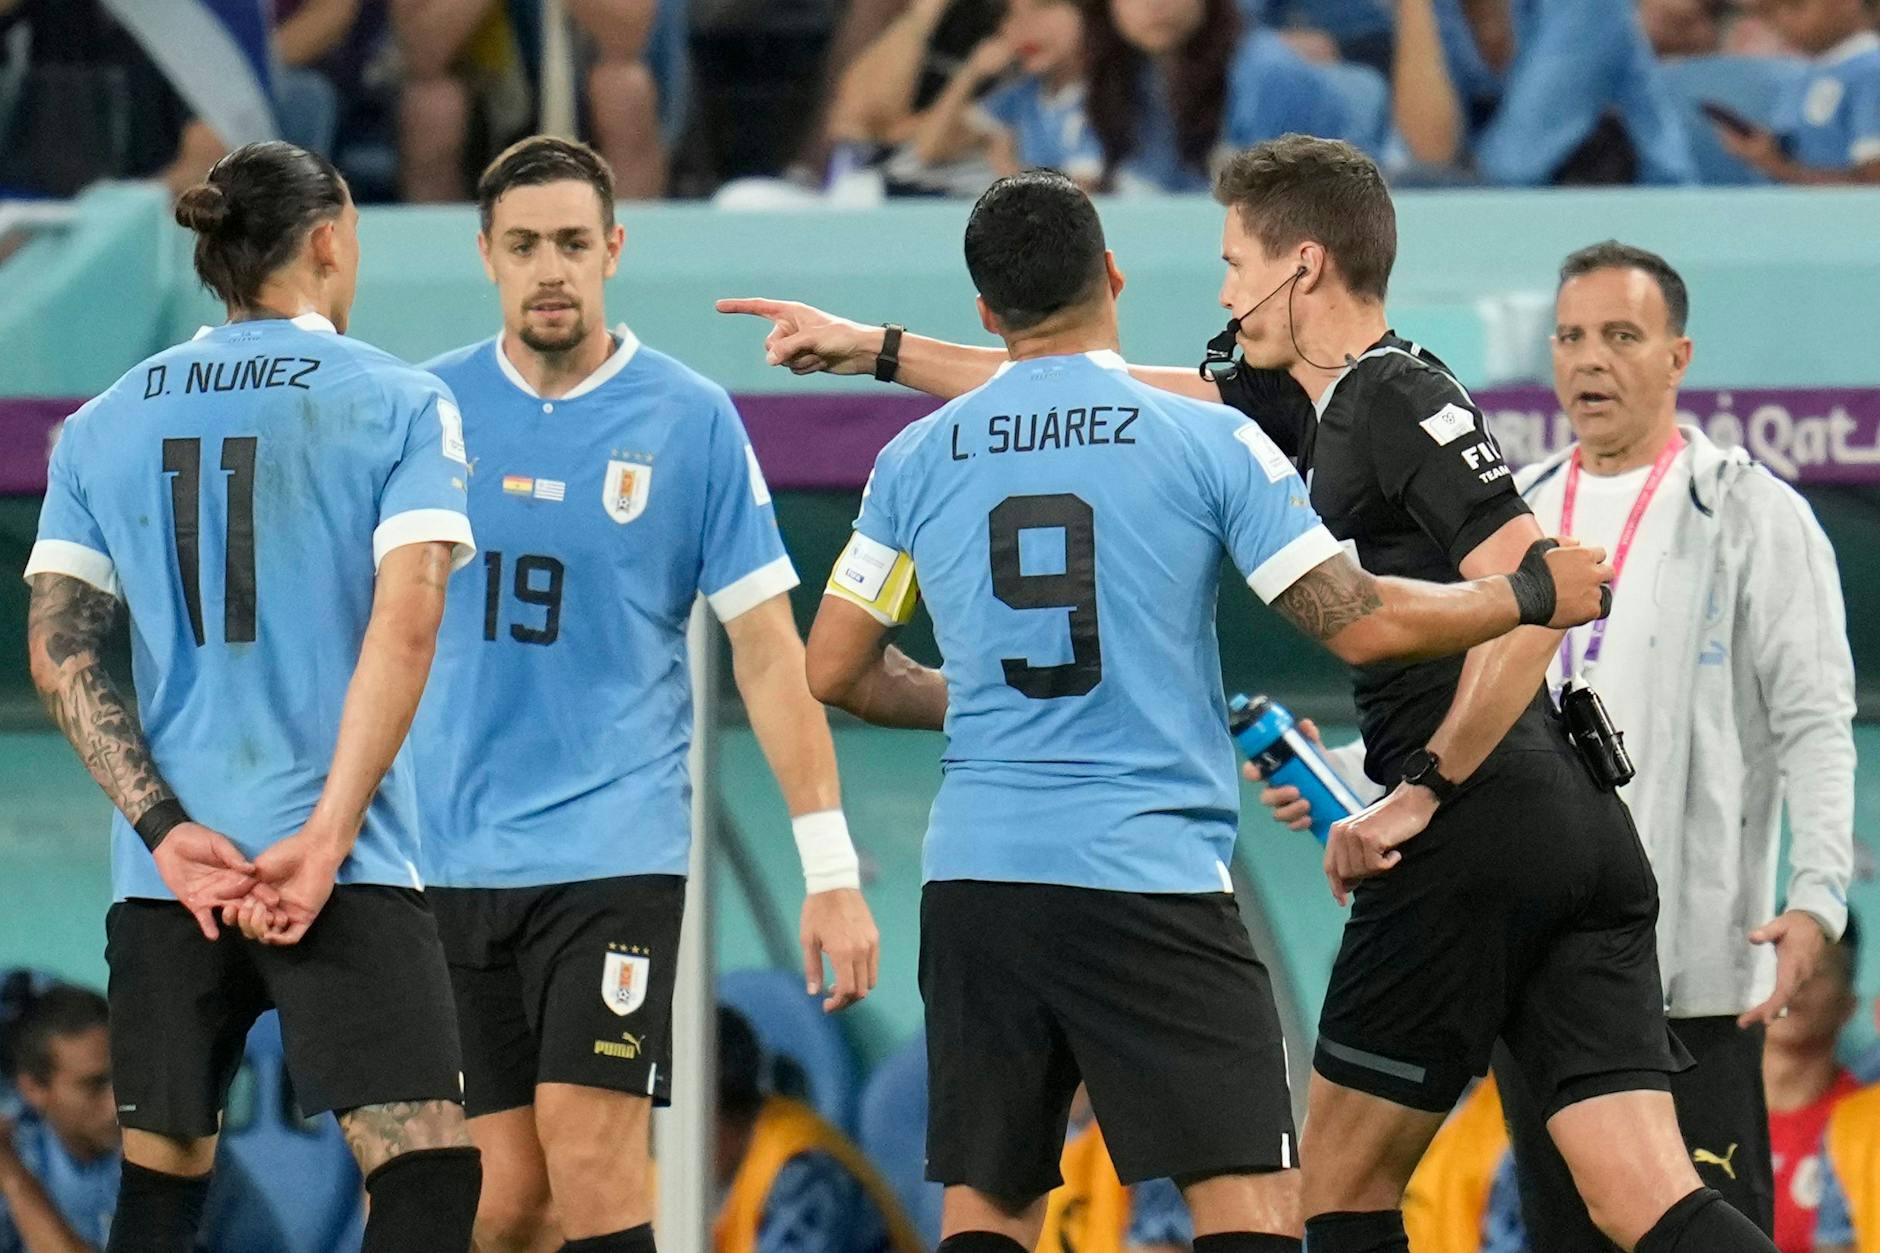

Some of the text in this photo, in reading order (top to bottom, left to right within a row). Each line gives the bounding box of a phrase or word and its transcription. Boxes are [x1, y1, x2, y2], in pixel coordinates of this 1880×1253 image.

[143, 355, 321, 400] D. NUÑEZ
[952, 407, 1139, 461] L. SUÁREZ
[1749, 404, 1880, 480] Qat
[162, 437, 258, 648] 11
[483, 551, 564, 647] 19
[989, 493, 1103, 699] 9
[594, 1040, 636, 1060] PUMA
